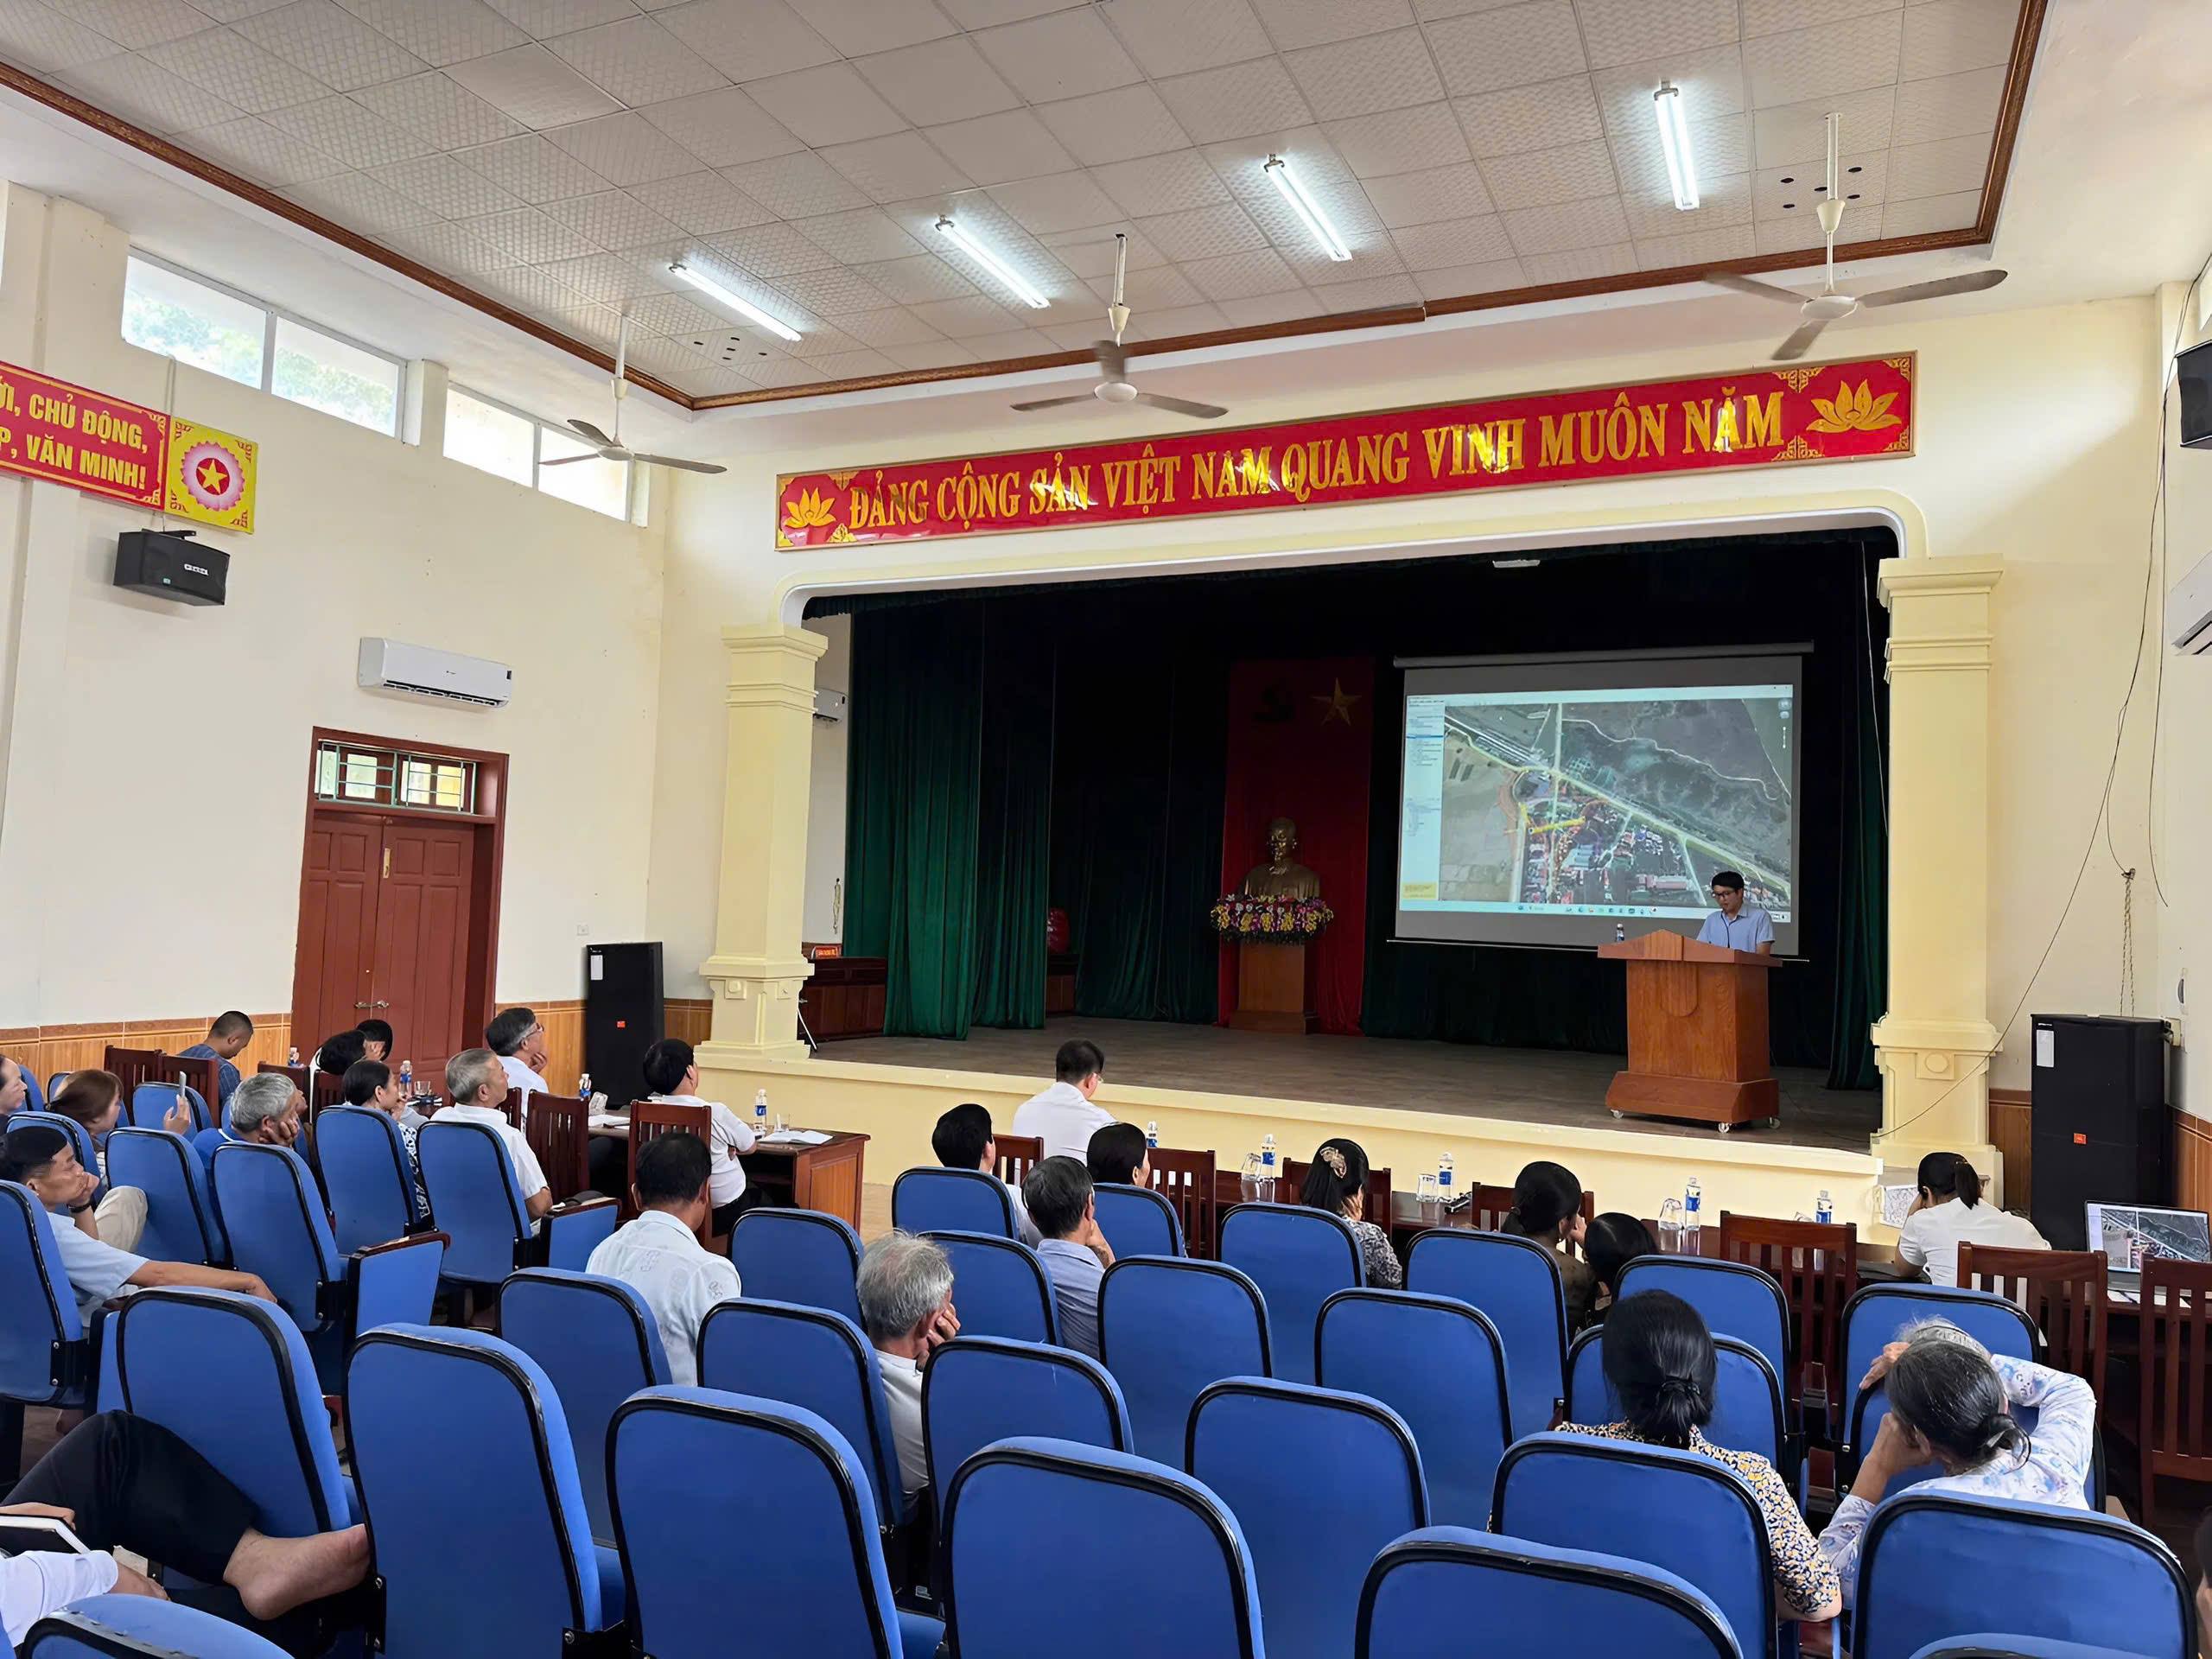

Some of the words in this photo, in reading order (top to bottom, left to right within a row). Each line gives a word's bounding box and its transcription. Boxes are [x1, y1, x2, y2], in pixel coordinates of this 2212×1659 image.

[29, 393, 76, 429] CHỦ
[82, 410, 148, 454] ĐỘNG,
[27, 433, 73, 471] VĂN
[79, 448, 146, 489] MINH!
[849, 469, 929, 530] ĐẢNG
[937, 461, 1020, 531] CỘNG
[1029, 451, 1090, 518] SẢN
[1101, 443, 1181, 514] VIỆT
[1192, 446, 1273, 500] NAM
[1281, 432, 1409, 502] QUANG
[1422, 418, 1527, 480] VINH
[1538, 391, 1669, 467] MUÔN
[1681, 386, 1784, 454] NĂM
